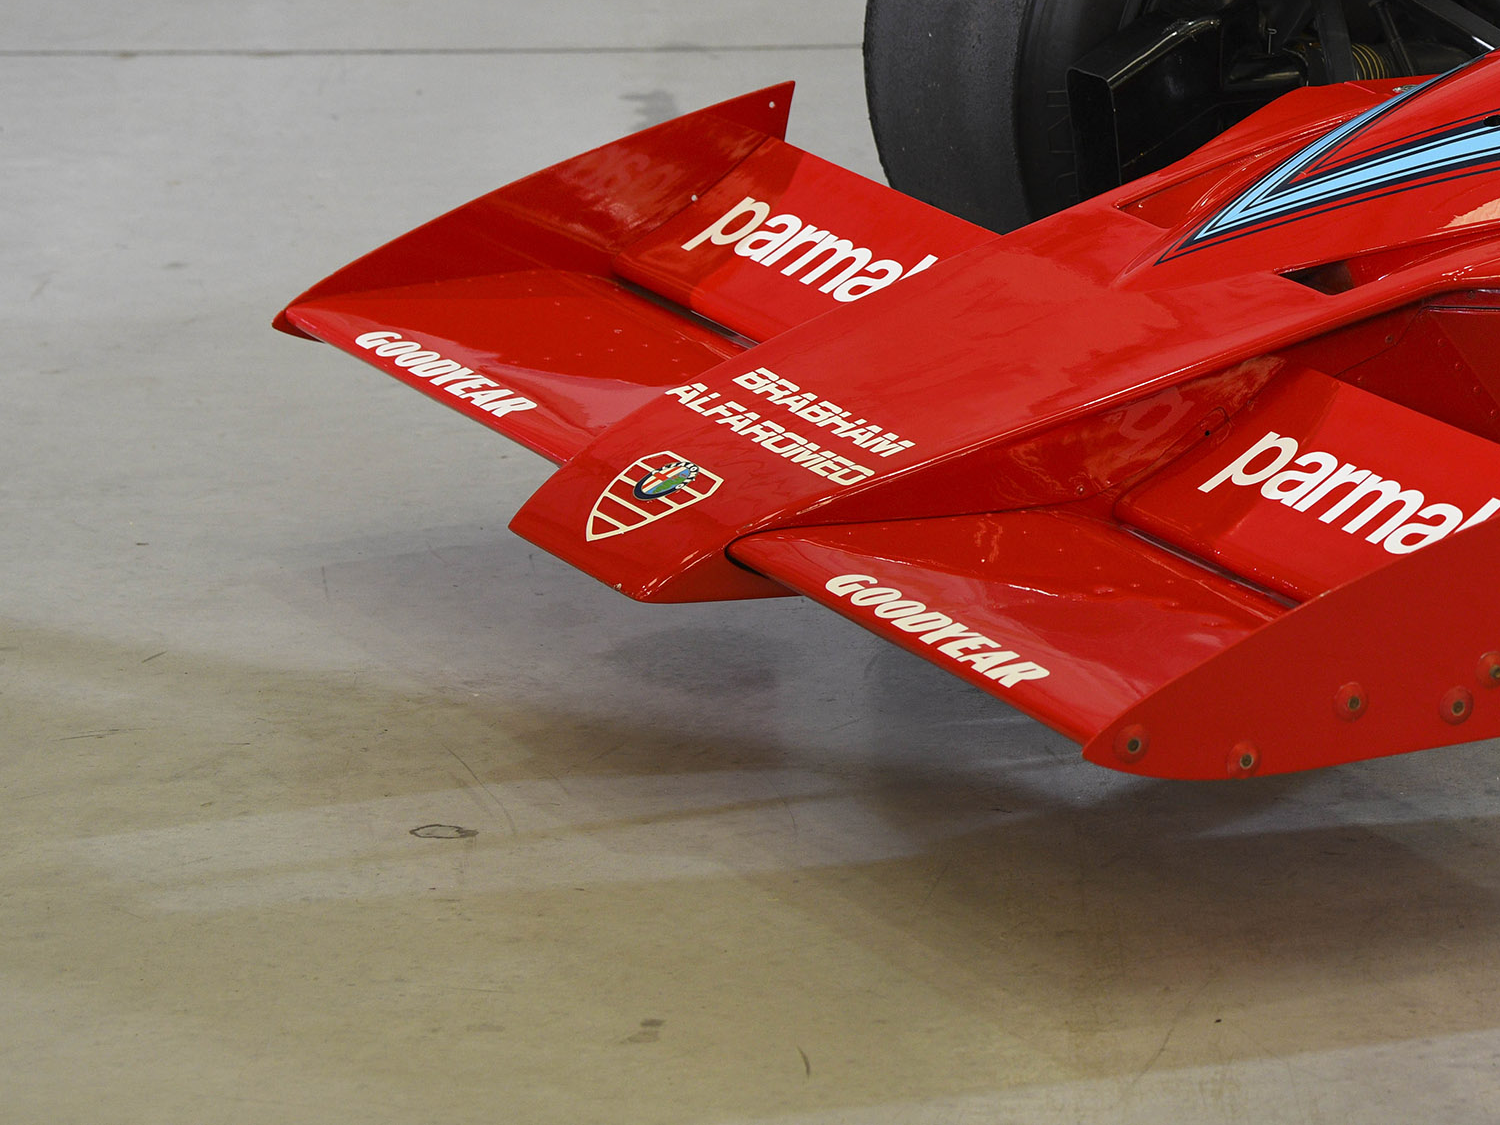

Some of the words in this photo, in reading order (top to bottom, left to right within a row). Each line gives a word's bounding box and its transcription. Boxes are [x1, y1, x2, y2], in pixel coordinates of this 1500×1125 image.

[355, 331, 537, 418] GOODYEAR
[732, 367, 916, 457] BRABHAM
[666, 382, 875, 486] ALFAROMEO
[825, 575, 1050, 688] GOODYEAR
